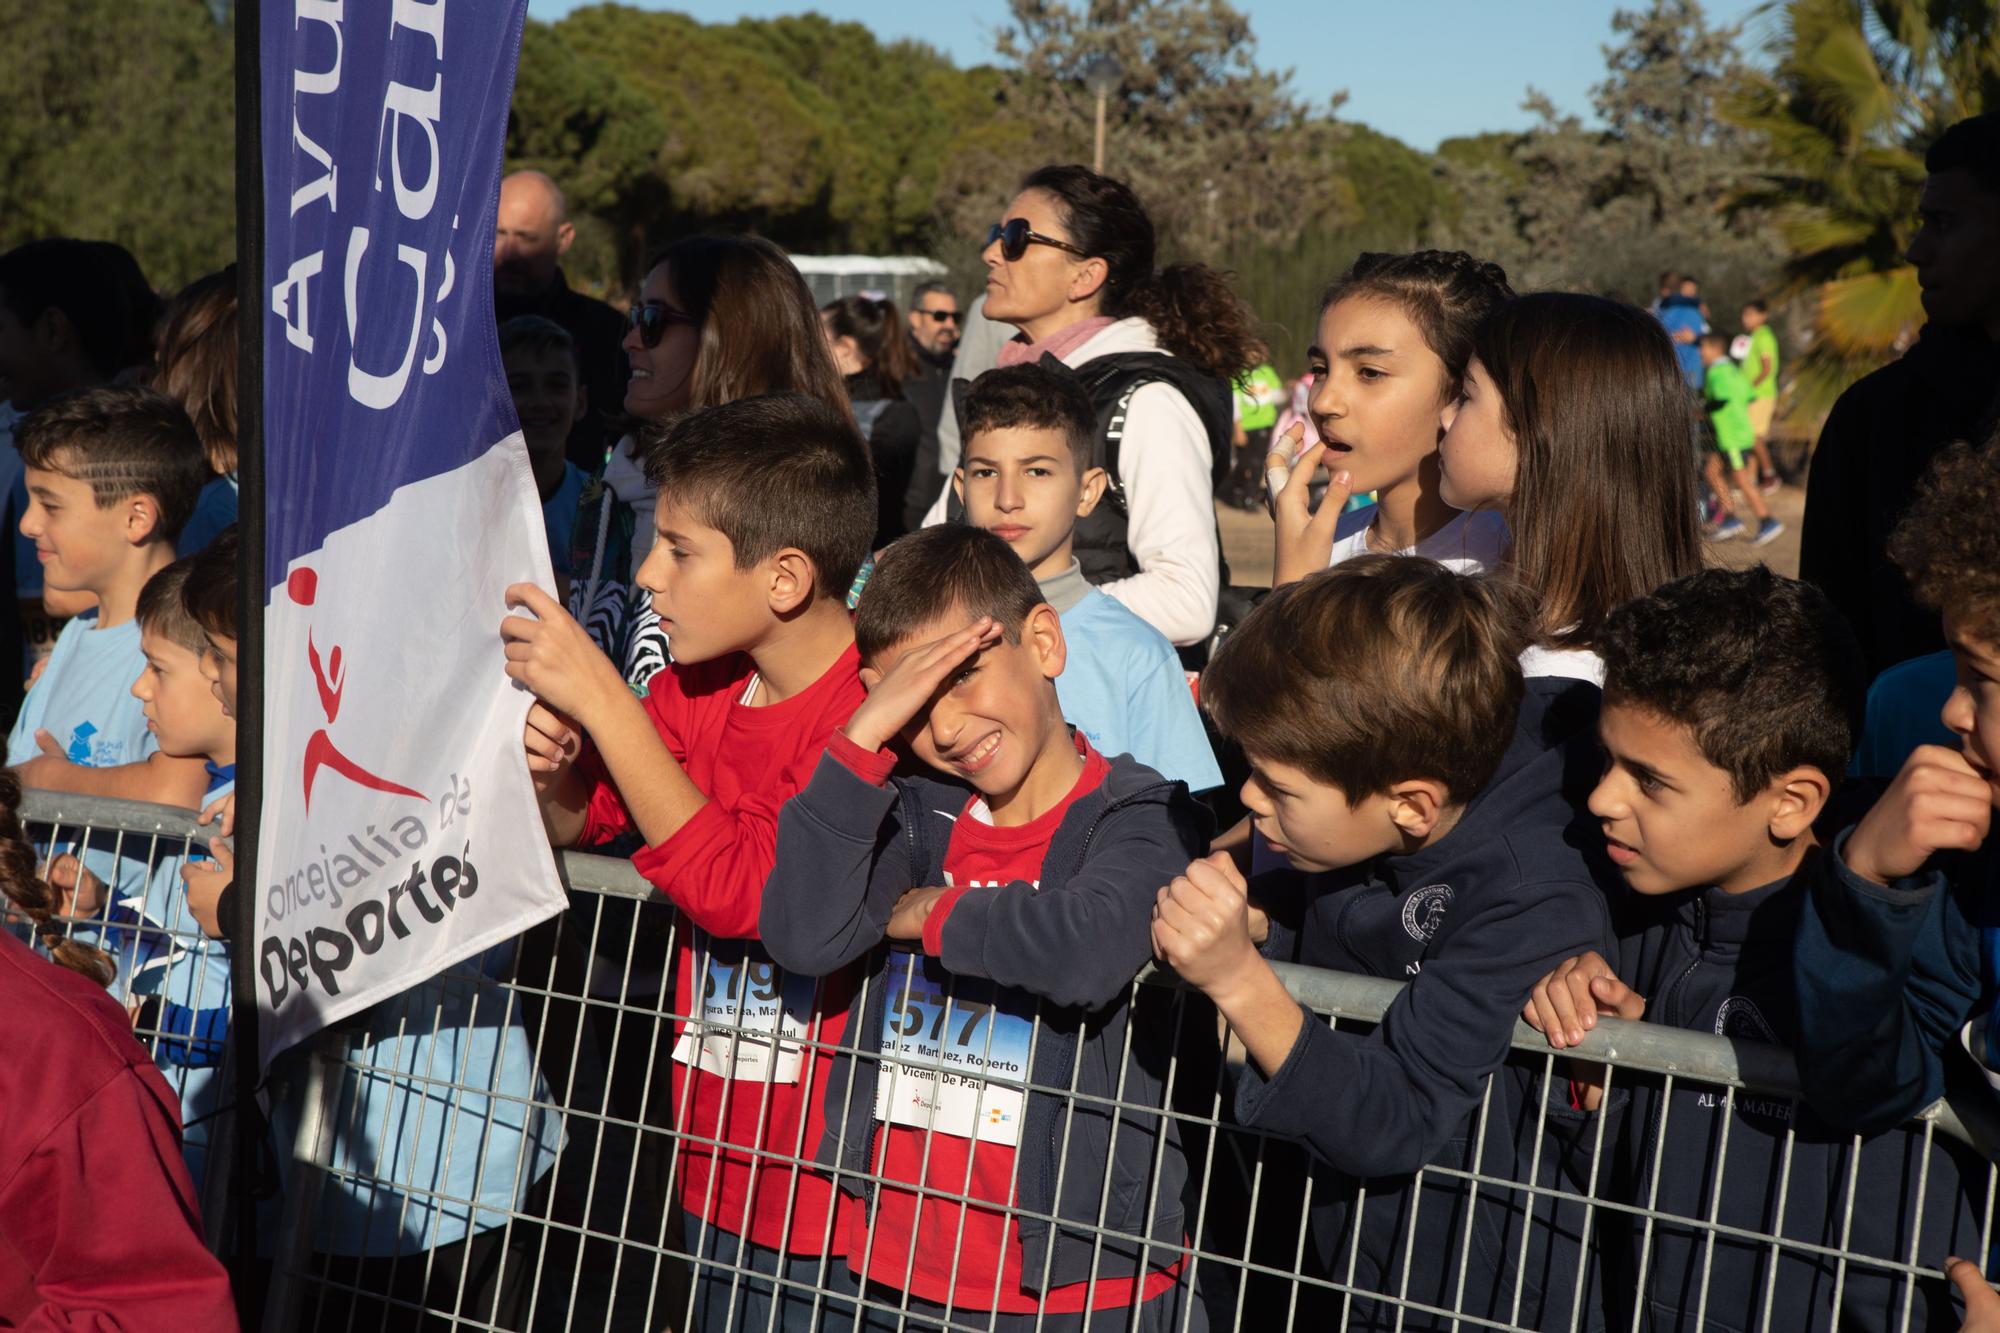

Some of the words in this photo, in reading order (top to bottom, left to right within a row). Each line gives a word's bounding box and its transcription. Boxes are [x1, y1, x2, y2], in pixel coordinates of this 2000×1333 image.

[264, 815, 428, 931] oncejalía
[889, 989, 991, 1047] 577
[917, 1044, 962, 1064] Martnez,
[966, 1053, 1019, 1072] Roberto
[941, 1073, 957, 1085] De
[960, 1076, 988, 1091] Paul
